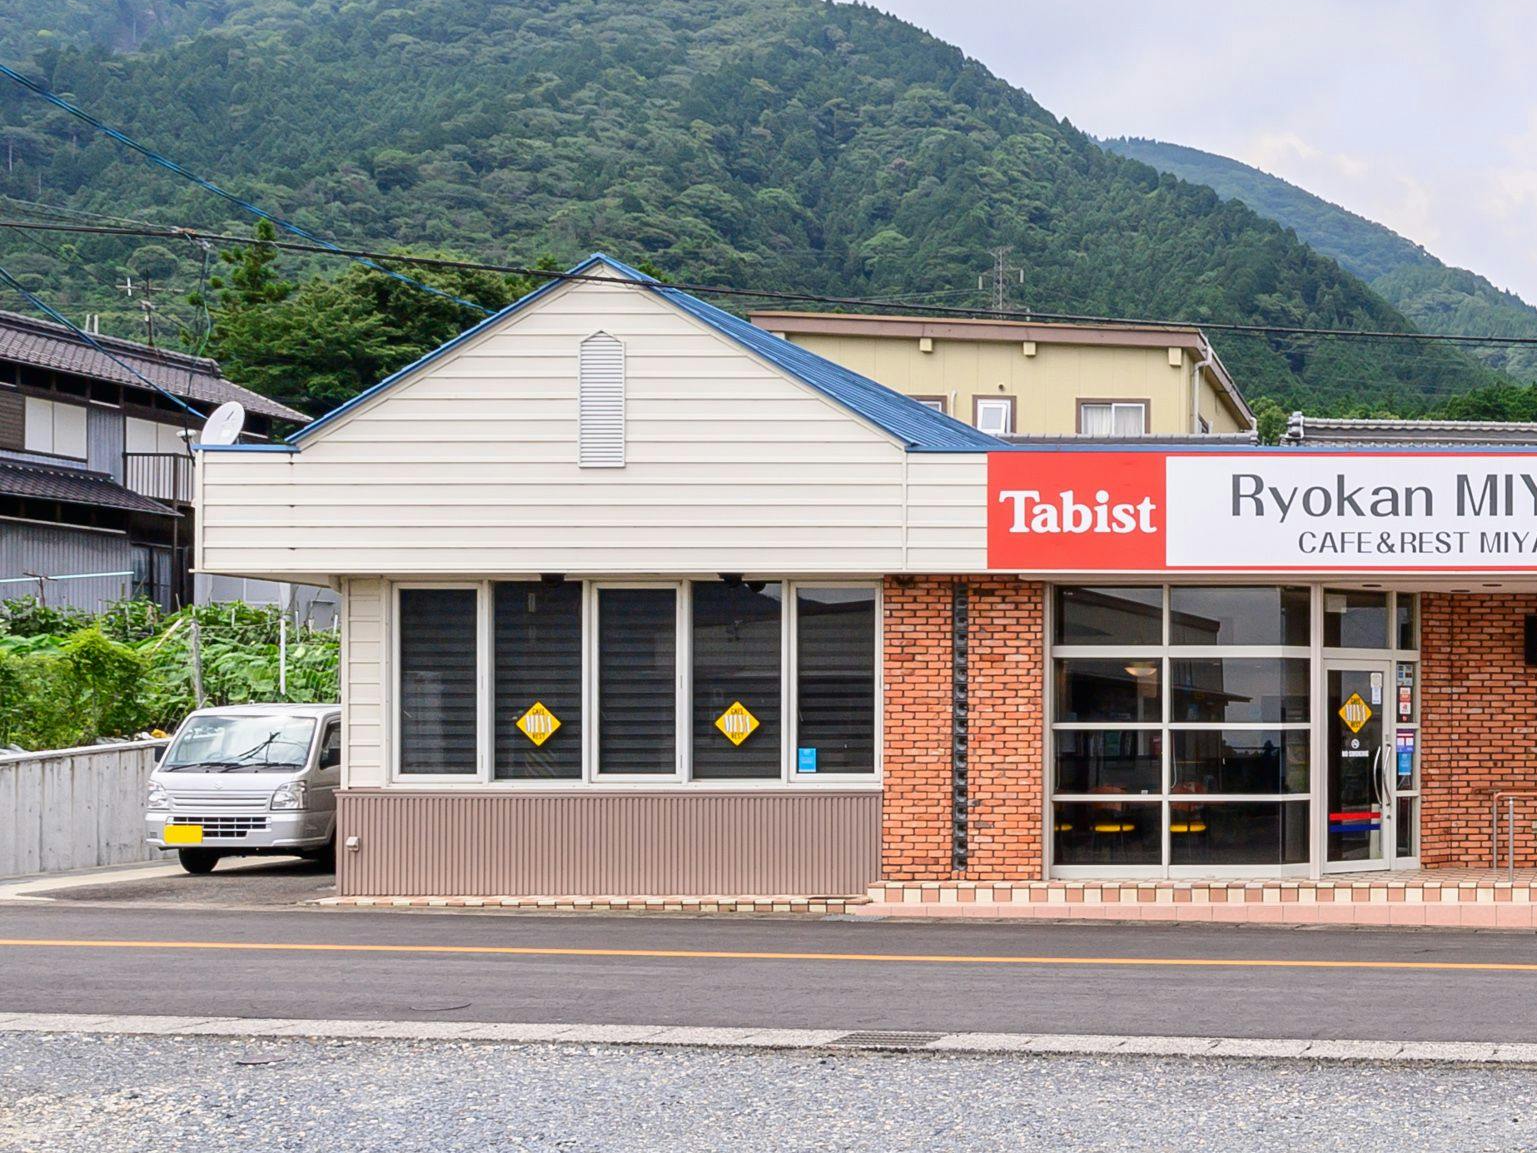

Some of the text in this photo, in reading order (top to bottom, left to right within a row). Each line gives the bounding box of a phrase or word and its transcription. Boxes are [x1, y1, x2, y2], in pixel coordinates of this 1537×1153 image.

[998, 489, 1158, 534] Tabist
[1232, 473, 1433, 524] Ryokan
[1298, 531, 1470, 554] CAFE&REST
